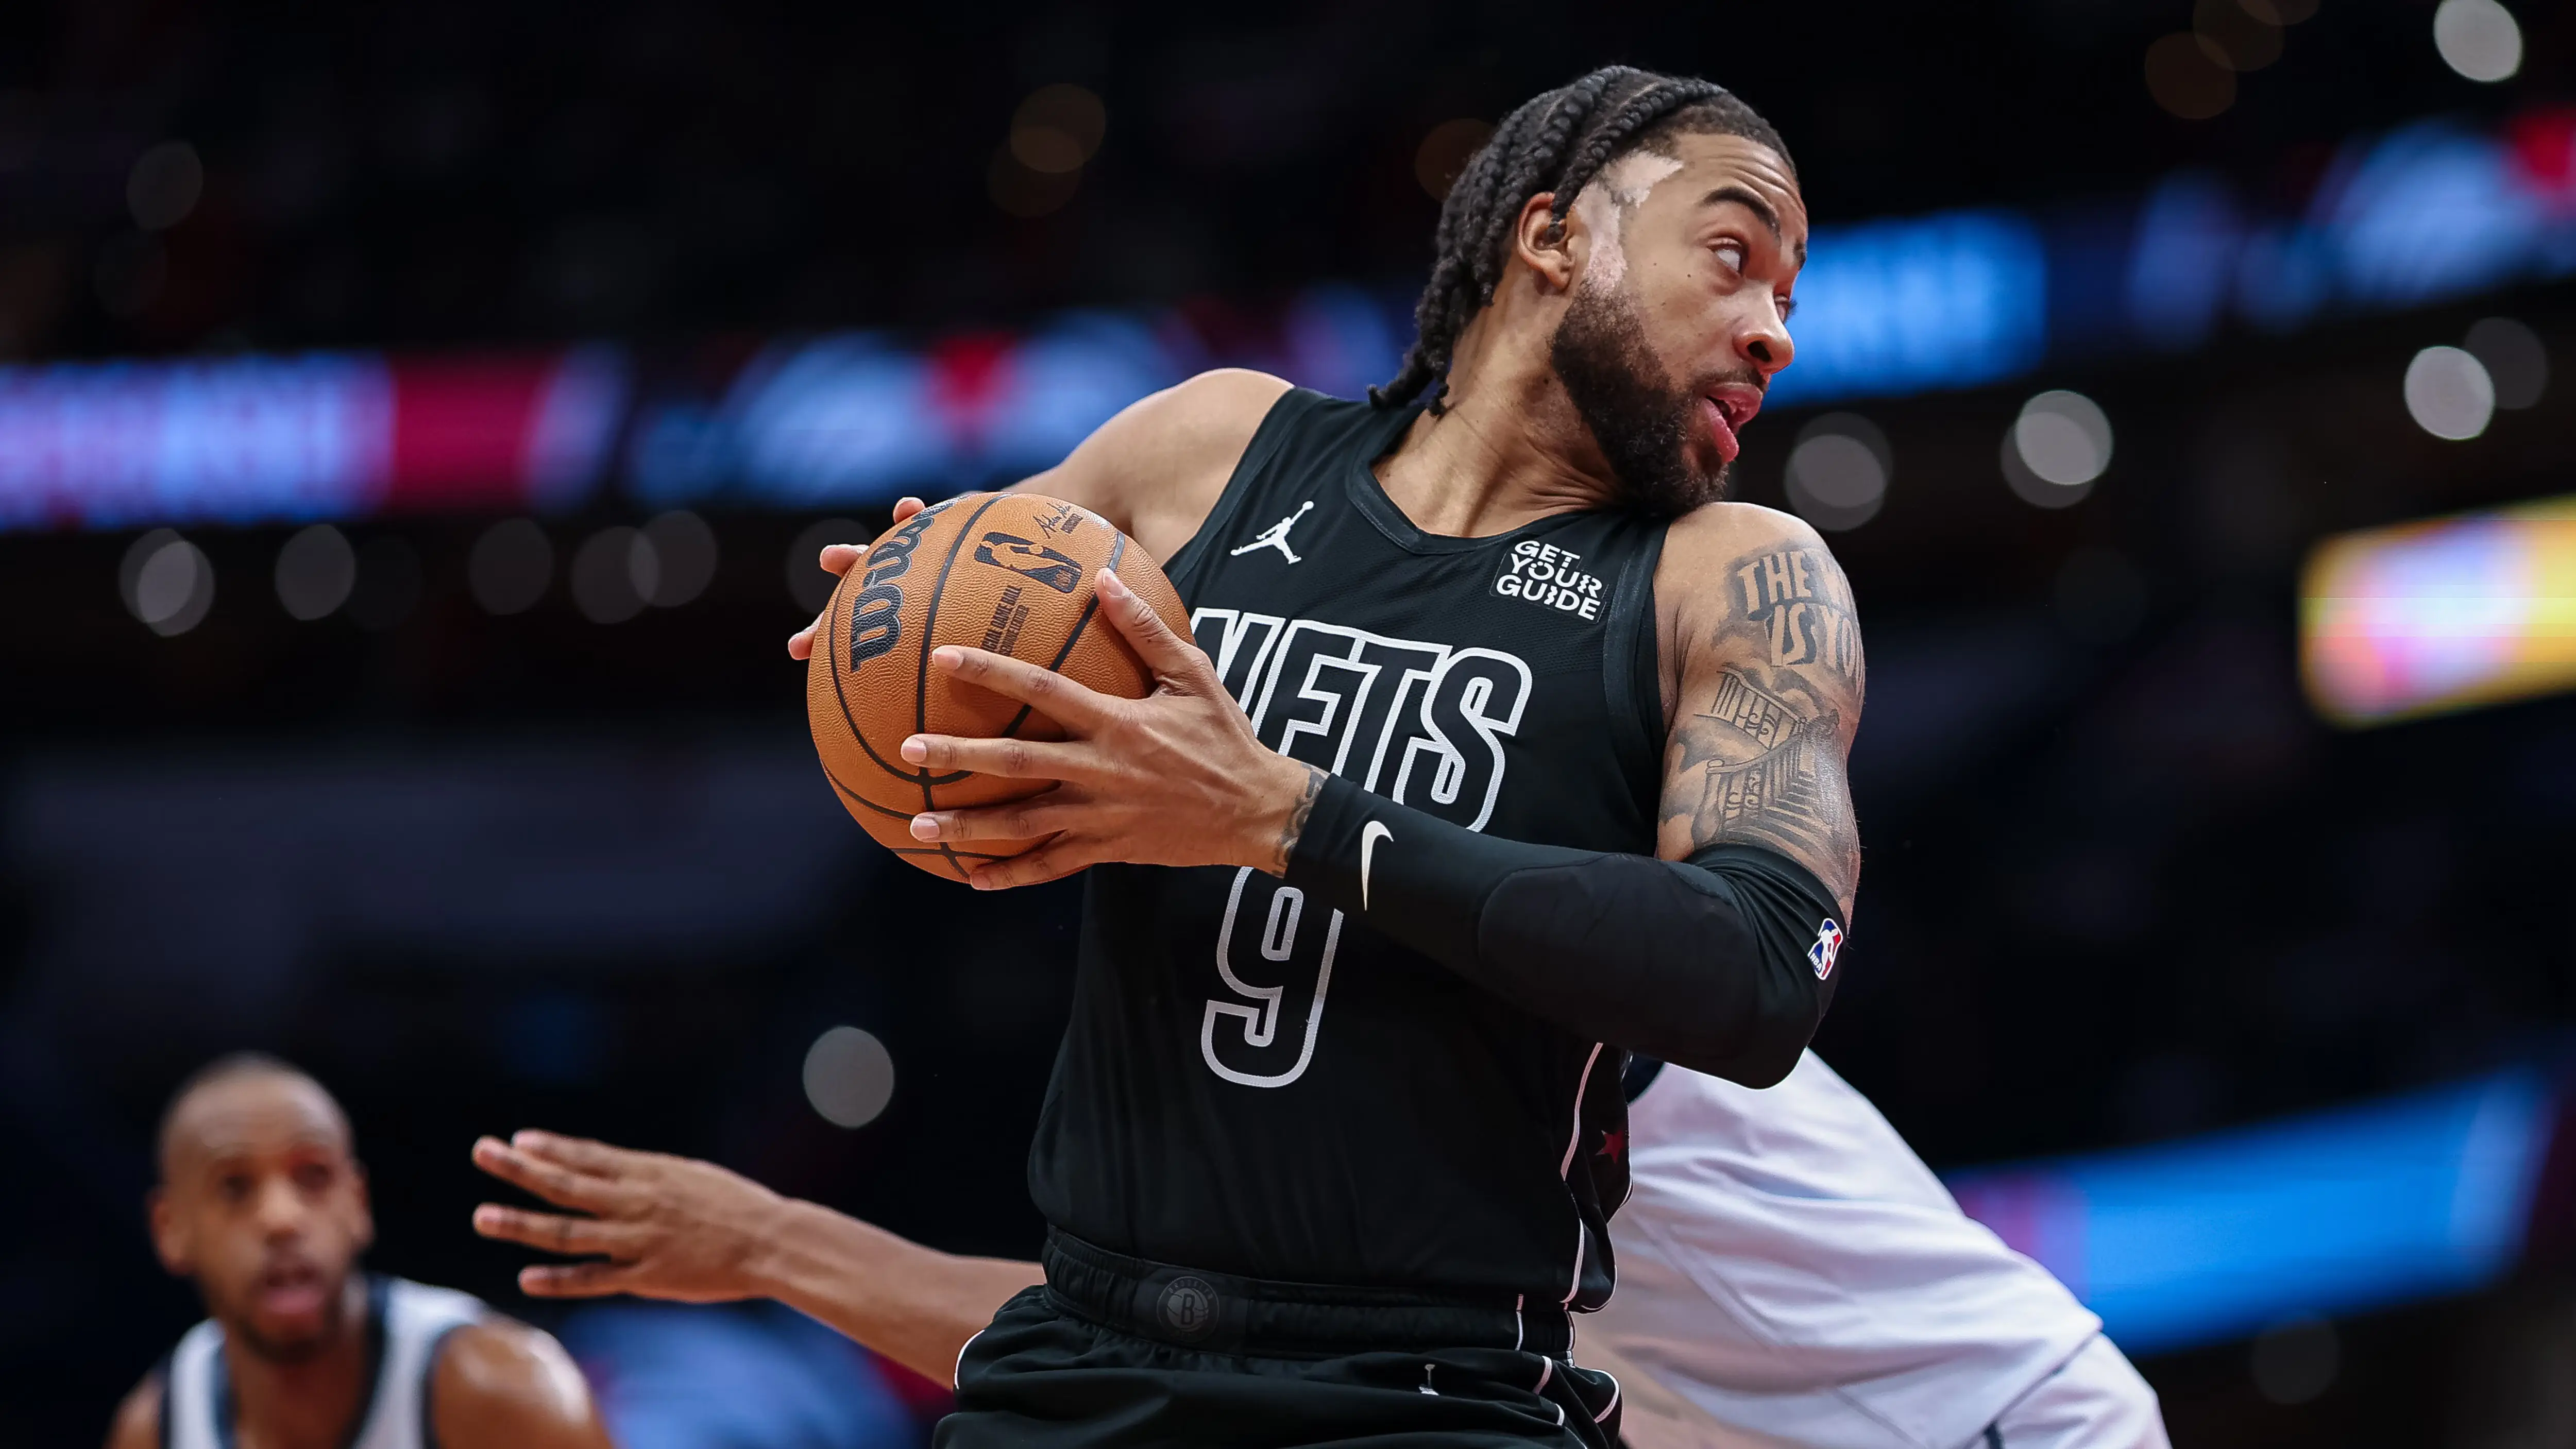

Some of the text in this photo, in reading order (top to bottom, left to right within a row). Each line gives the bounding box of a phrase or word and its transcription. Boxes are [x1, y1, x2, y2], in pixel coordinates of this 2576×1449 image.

[1511, 553, 1602, 598] YOUR
[1515, 540, 1581, 568] GET
[1001, 585, 1023, 606] BALL
[1496, 574, 1601, 620] GUIDE
[1737, 551, 1811, 615] THE
[990, 603, 1013, 629] GAME
[1770, 602, 1806, 667] IS
[1190, 607, 1533, 832] NETS
[1201, 866, 1344, 1088] 9
[1809, 952, 1823, 971] NBA
[1181, 1293, 1196, 1325] B
